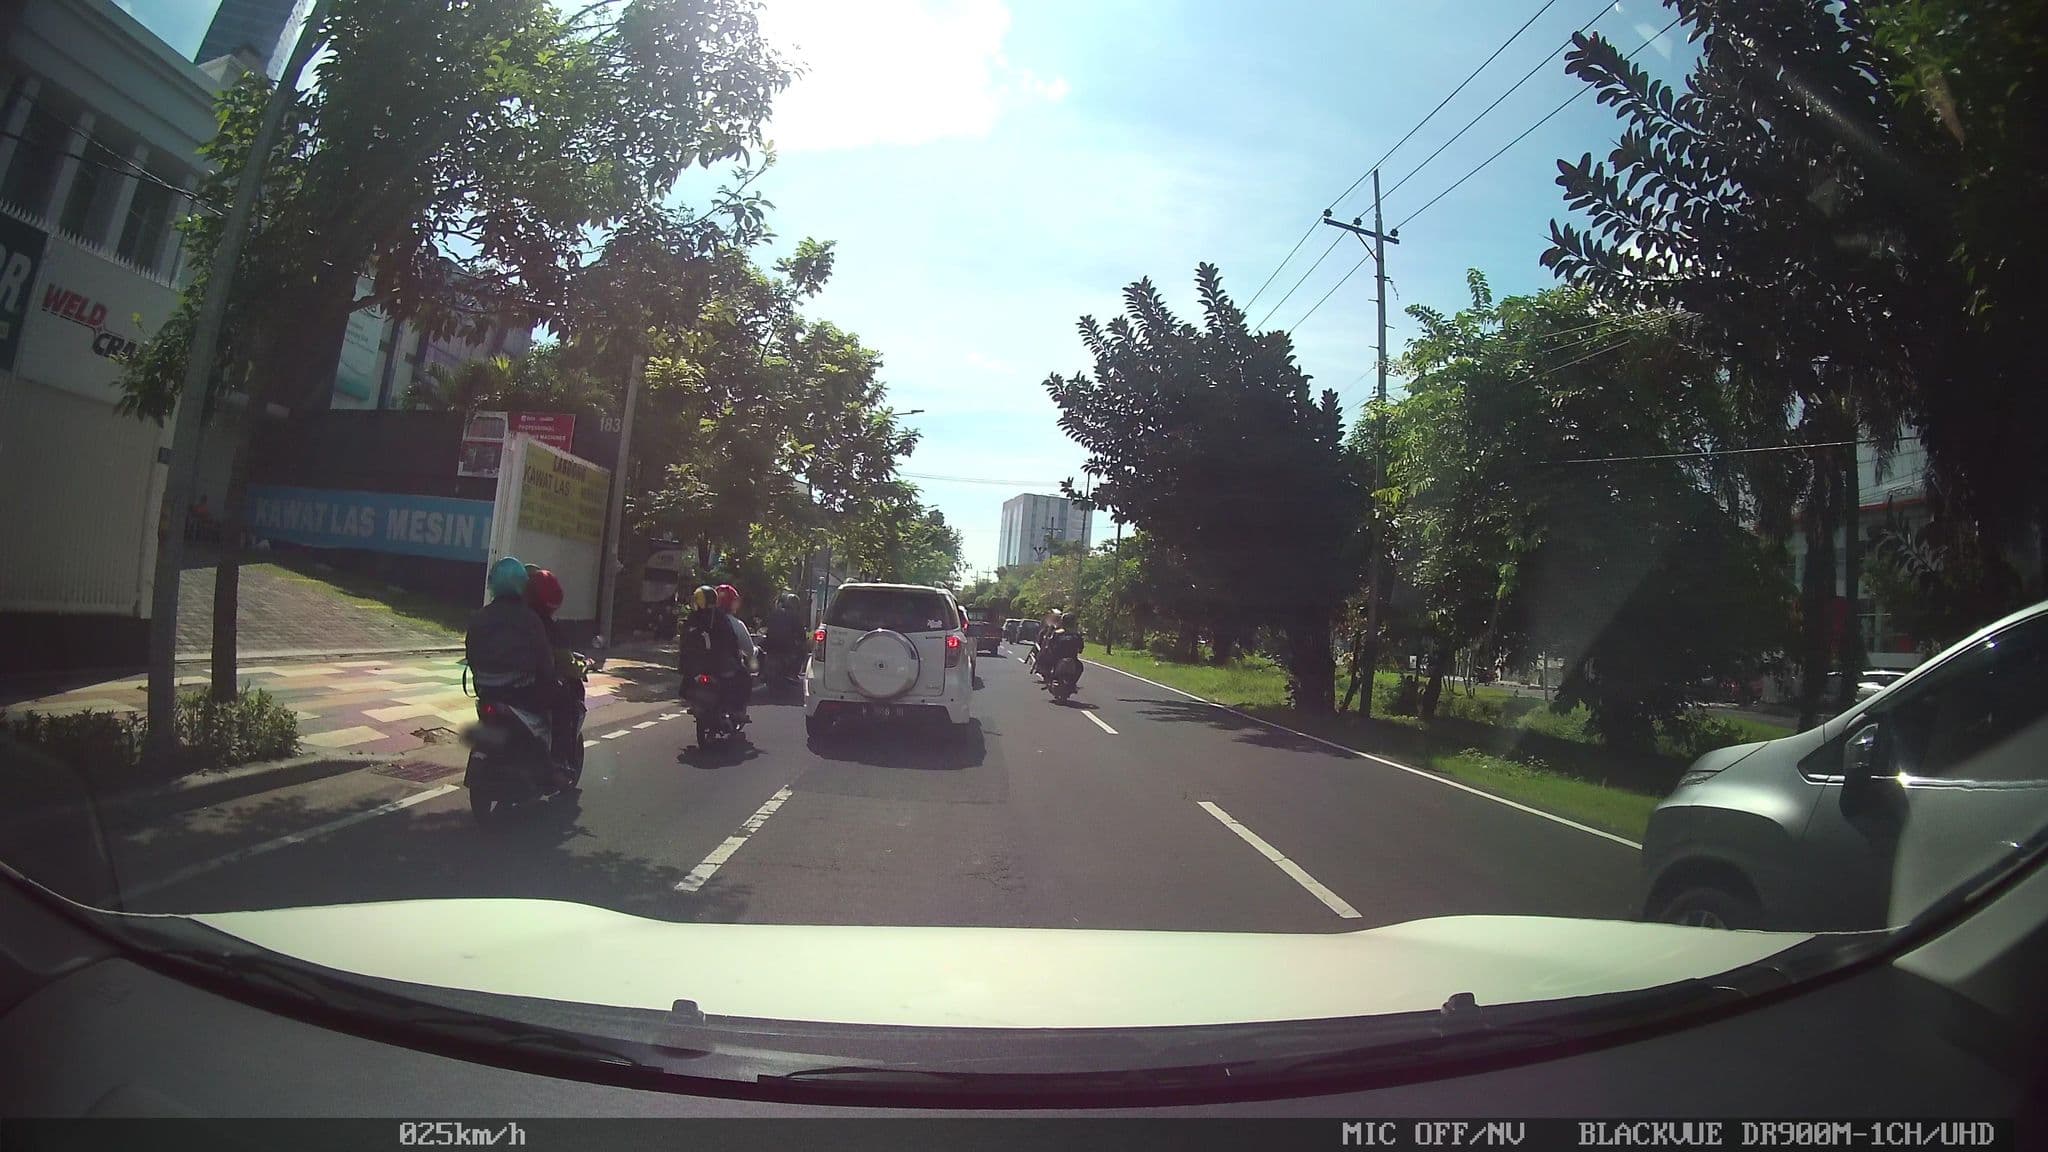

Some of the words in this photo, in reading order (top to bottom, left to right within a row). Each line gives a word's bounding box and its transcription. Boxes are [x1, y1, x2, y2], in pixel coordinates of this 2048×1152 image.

[42, 283, 107, 326] WELD
[600, 417, 621, 433] 183
[554, 477, 570, 497] LAS
[255, 499, 328, 531] KAWAT
[329, 503, 376, 538] LAS
[386, 508, 475, 549] MESIN
